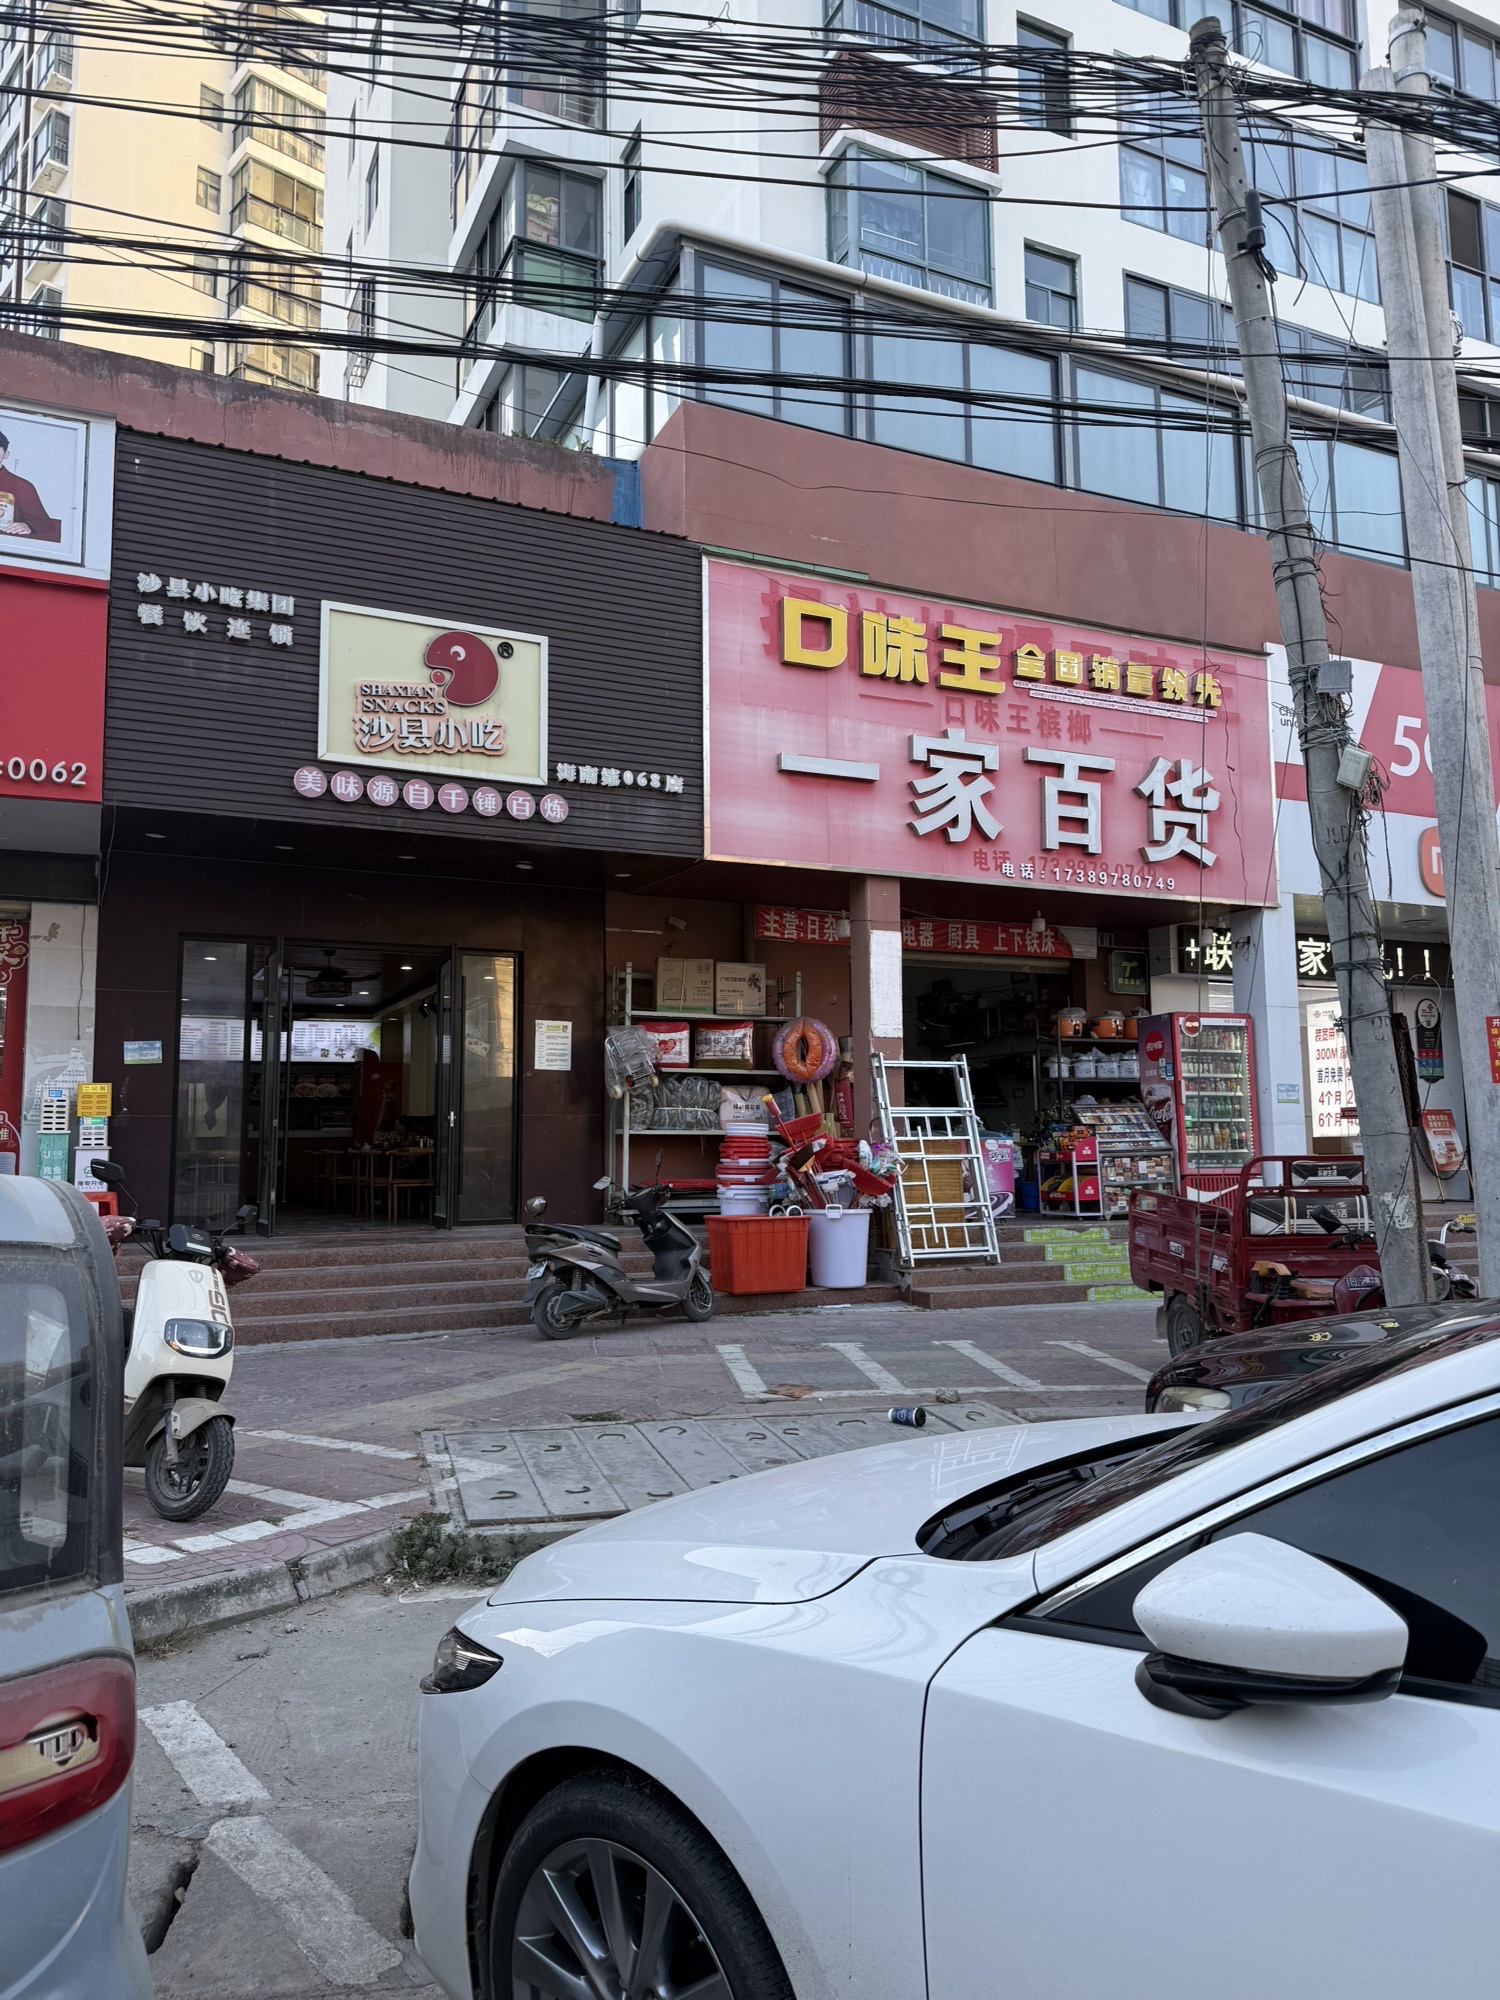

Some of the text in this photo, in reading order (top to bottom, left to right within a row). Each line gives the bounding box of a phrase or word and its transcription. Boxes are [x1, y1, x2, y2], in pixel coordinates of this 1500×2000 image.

[137, 572, 295, 616] 沙县小吃集团
[137, 603, 294, 646] 餐饮连锁
[781, 597, 1006, 695] 口味王
[361, 684, 435, 698] SHAXIAN
[1013, 643, 1222, 708] 全国销量领先
[362, 699, 446, 715] SNACKS
[359, 716, 504, 750] 沙县小吃
[1389, 715, 1433, 777] 5
[297, 769, 567, 820] 美味源自千锤百炼
[556, 763, 684, 793] 海南第068店
[777, 728, 1221, 868] 一家百货
[993, 926, 1056, 954] 上下铁床
